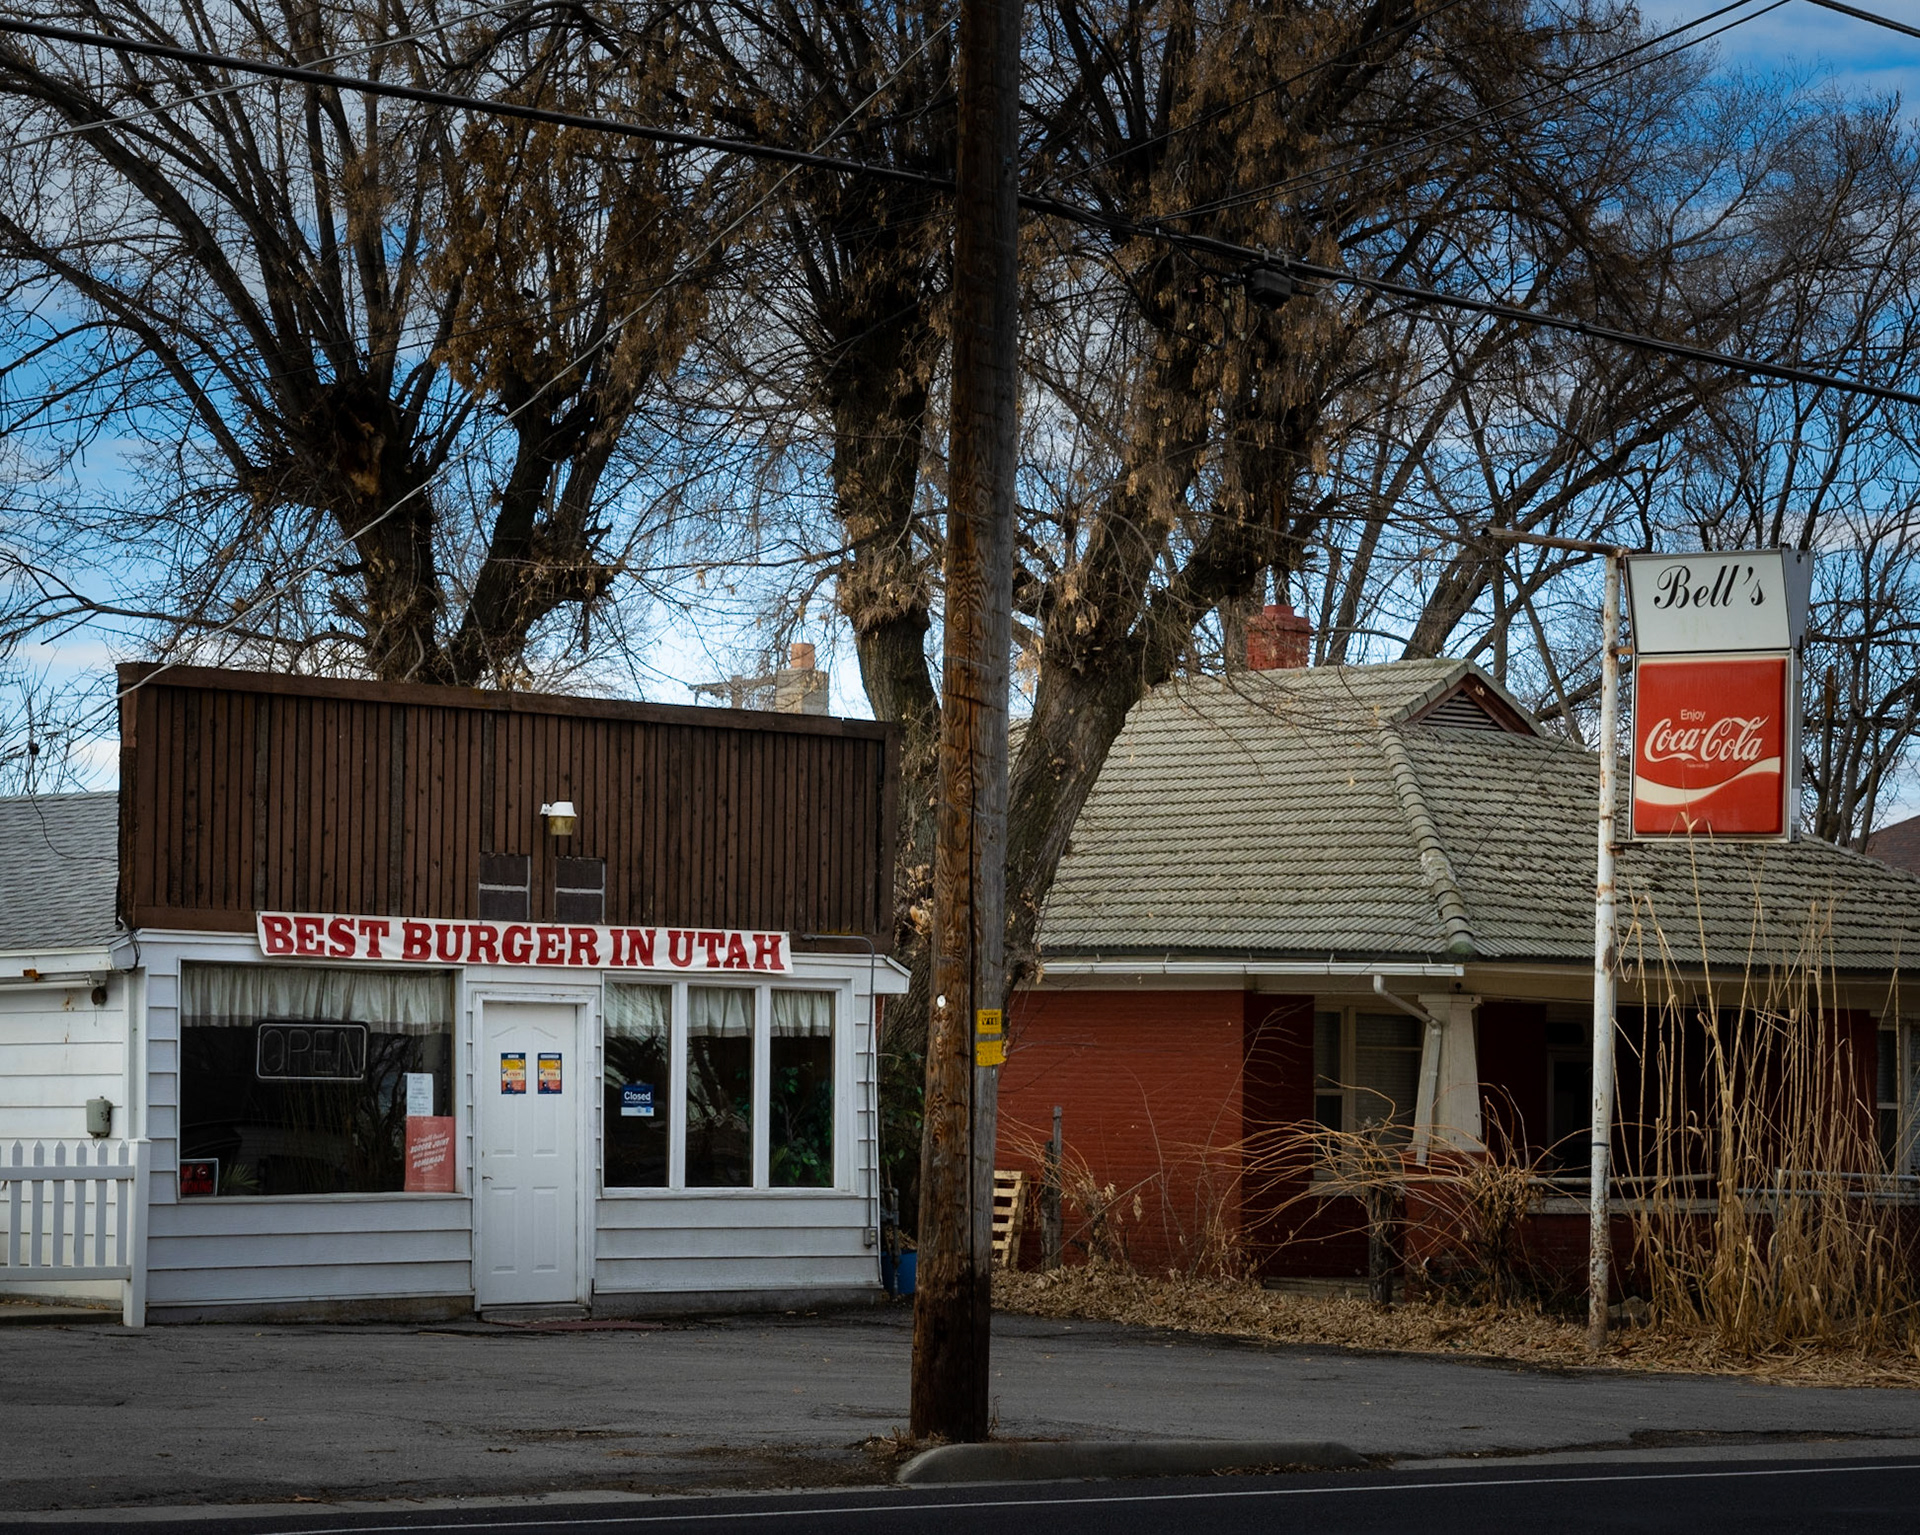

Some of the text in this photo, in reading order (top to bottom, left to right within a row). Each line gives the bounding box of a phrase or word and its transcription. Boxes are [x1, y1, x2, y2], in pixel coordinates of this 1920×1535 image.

[1653, 564, 1767, 609] Bell's
[1680, 709, 1706, 722] Enjoy
[1644, 715, 1769, 763] Coca-Cola
[261, 915, 785, 971] BEST BURGER IN UTAH
[261, 1029, 361, 1075] OPEN
[623, 1091, 652, 1101] Closed
